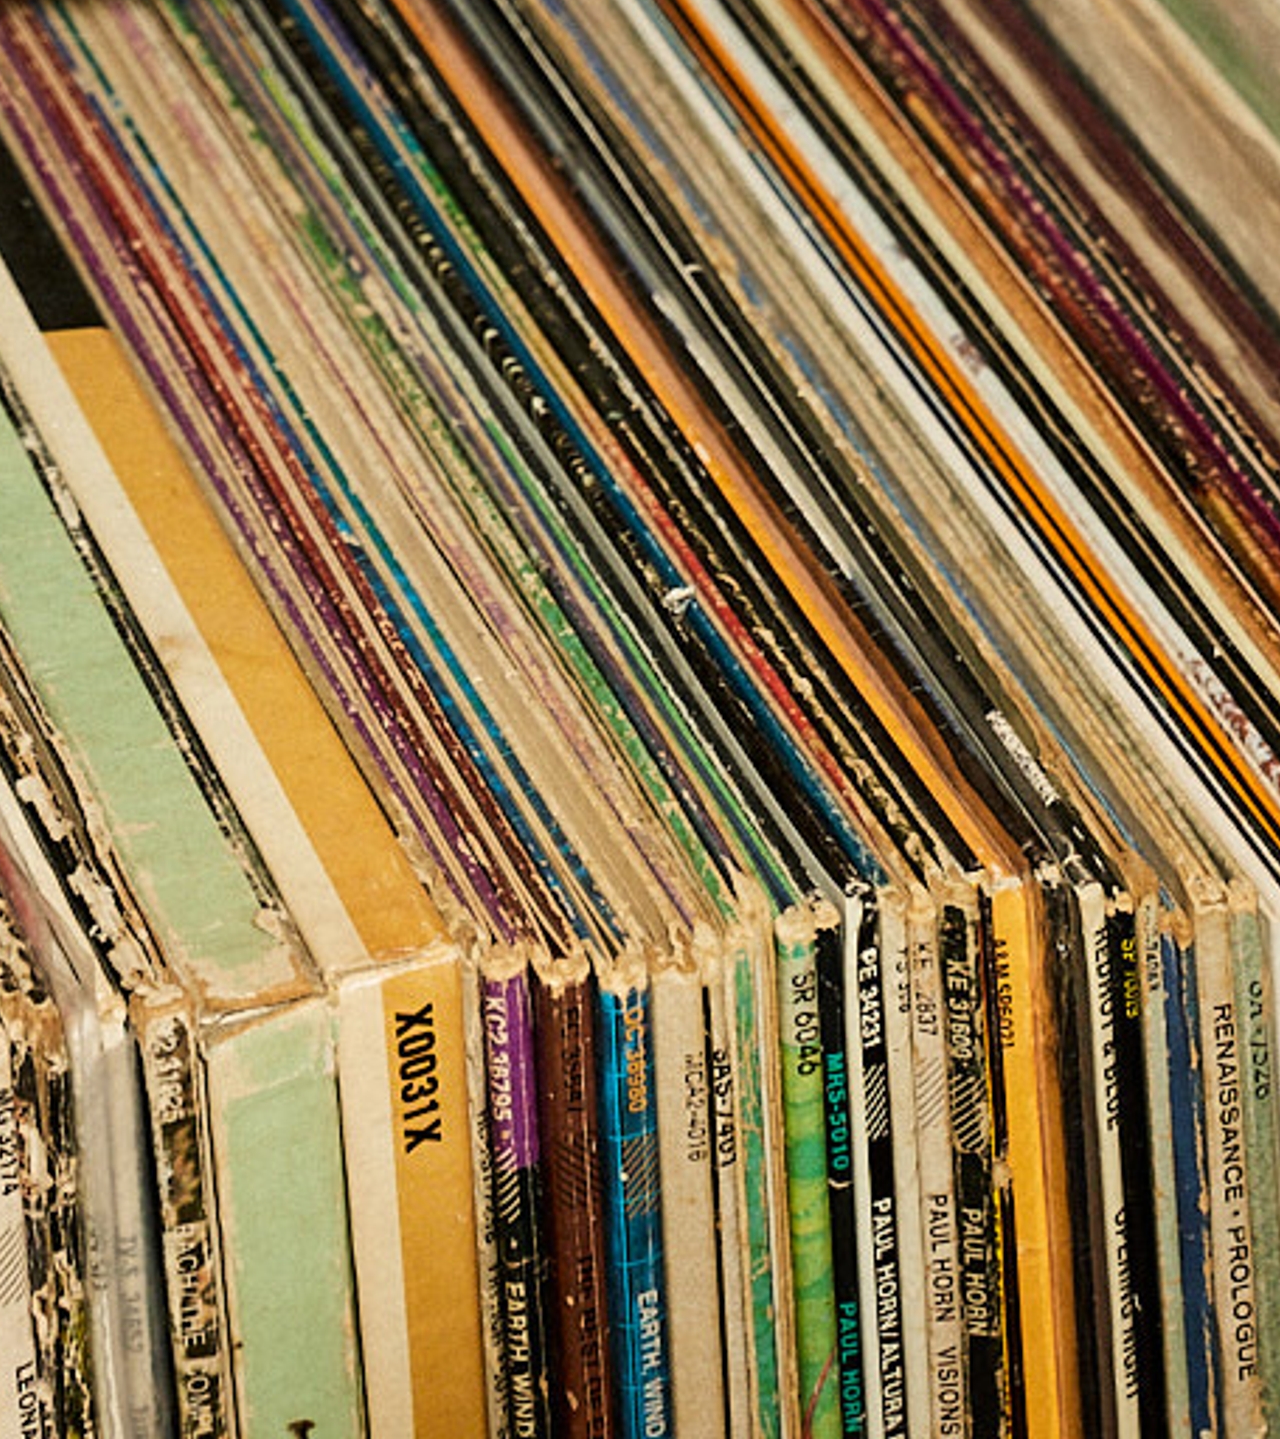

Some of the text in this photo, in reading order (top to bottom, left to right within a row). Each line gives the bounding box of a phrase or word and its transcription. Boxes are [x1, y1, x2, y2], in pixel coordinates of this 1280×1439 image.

[395, 1004, 443, 1154] X0031X
[793, 971, 820, 1075] SR 6046
[860, 986, 898, 1260] 34231 PAUL
[946, 958, 988, 1335] KE PAUL HORN
[1214, 1004, 1255, 1382] RENAISSANCE PROLOGUE
[838, 1302, 863, 1432] PAUL HORN
[928, 1195, 961, 1435] PAUL HORN VISIONS
[514, 1372, 536, 1438] WIND
[644, 1378, 666, 1437] WIND
